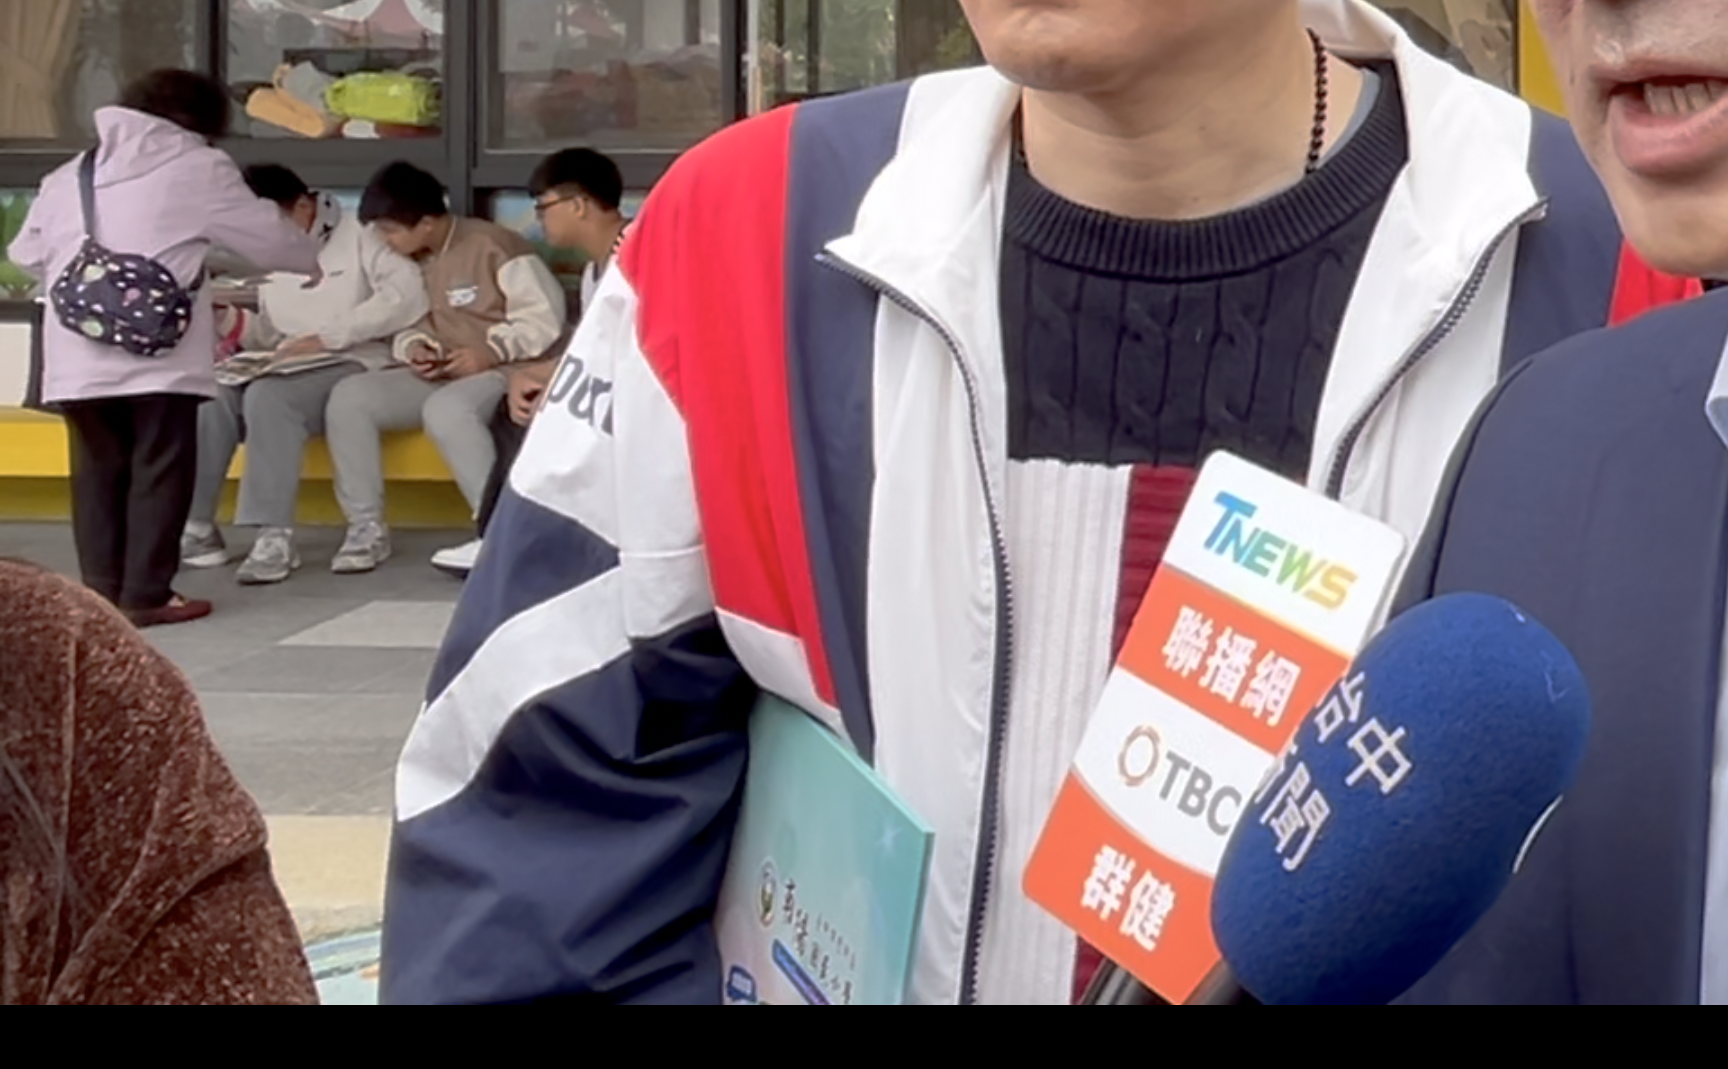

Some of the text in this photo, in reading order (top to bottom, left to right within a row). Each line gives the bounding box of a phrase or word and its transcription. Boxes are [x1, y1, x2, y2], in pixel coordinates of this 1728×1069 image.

[1203, 491, 1358, 610] TNEWS
[1162, 605, 1300, 727] 聯播網
[1160, 752, 1241, 835] TBC
[1254, 743, 1332, 872] 聞
[1081, 845, 1176, 952] 群健
